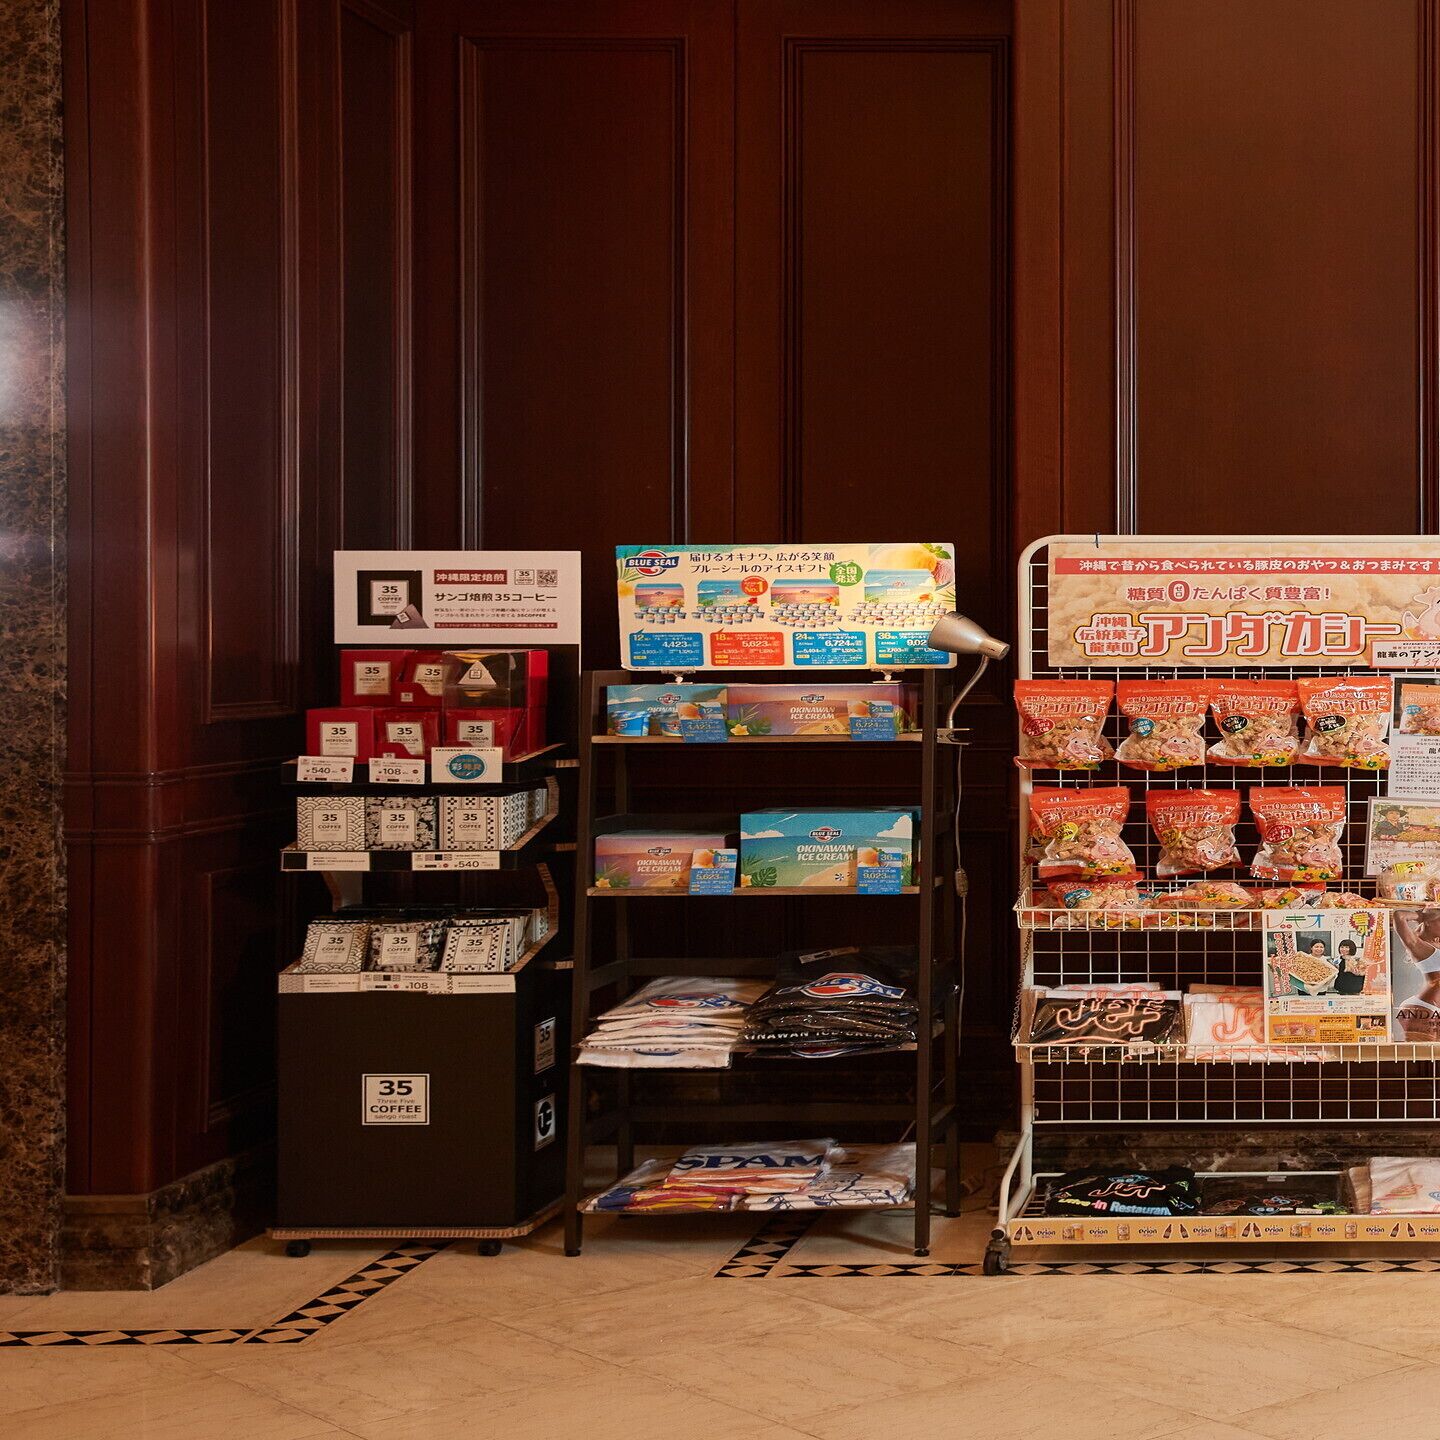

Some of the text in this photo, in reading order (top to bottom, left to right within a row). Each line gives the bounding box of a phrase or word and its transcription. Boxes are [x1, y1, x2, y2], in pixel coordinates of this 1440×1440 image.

[689, 551, 835, 562] 届けるオキナワ、広がる笑顔
[628, 558, 677, 567] BLUE SEAL
[690, 564, 826, 573] ブルーシールのアイスギフト
[835, 566, 858, 575] 全国
[435, 573, 506, 582] 沖縄限定焙煎
[381, 585, 398, 593] 35
[434, 592, 557, 602] サンゴ焙煎35コーヒー
[1096, 616, 1128, 628] 沖縄
[1079, 629, 1143, 641] 伝統菓子
[1143, 613, 1399, 654] アンダカシー
[364, 666, 380, 674] 35
[424, 668, 441, 676] 35
[789, 706, 835, 714] OKINAWAN
[331, 727, 347, 735] 35
[396, 727, 413, 735] 35
[467, 725, 483, 733] 35
[462, 813, 478, 821] 35
[796, 844, 856, 853] OKINAWAN
[797, 853, 854, 861] ICE CREAM
[636, 859, 682, 867] OKINAWAN
[466, 939, 483, 947] 35
[378, 1080, 413, 1096] 35
[370, 1105, 422, 1113] COFFEE
[674, 1154, 825, 1170] SPAM
[1110, 1201, 1172, 1216] Restauran
